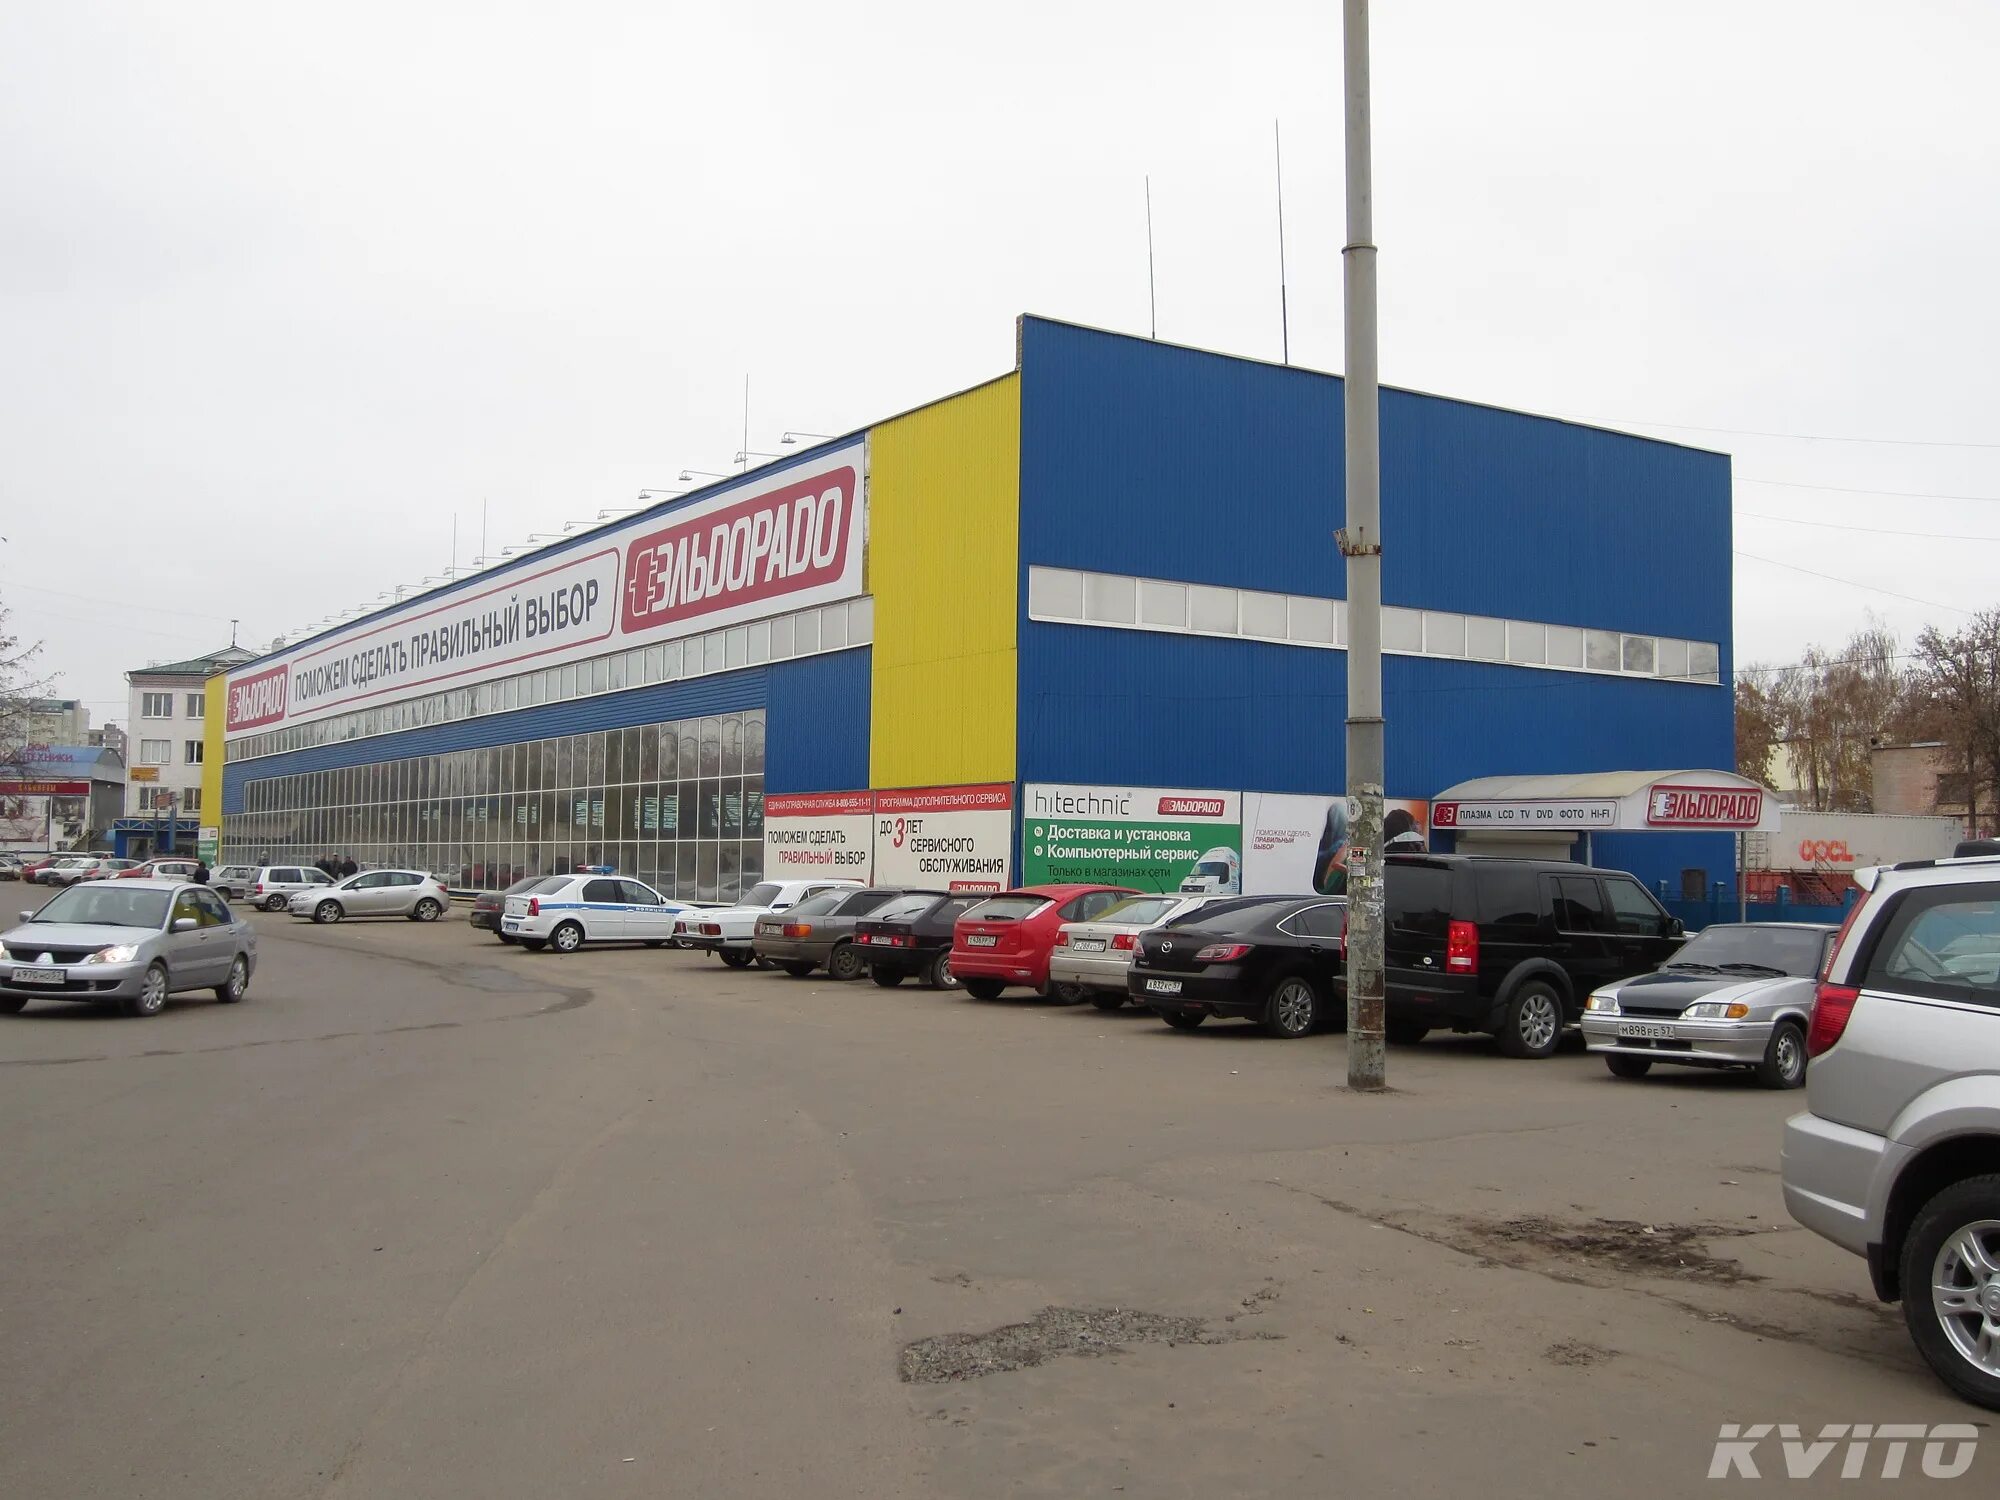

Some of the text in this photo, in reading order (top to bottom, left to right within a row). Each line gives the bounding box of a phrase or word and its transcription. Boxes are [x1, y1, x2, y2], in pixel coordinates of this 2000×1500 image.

[295, 578, 599, 702] ПОМОЖЕМ СДЕЛАТЬ ПРАВИЛЬНЫЙ ВЫБОР
[768, 797, 871, 810] ЕДИНАЯ СПРАВОЧНАЯ СЛУЖБА 8-800-555-11-11
[879, 792, 1006, 808] ПРОГРАММА ДОПОЛНИТЕЛЬНОГО СЕРВИСА
[1035, 790, 1130, 818] hitechnic
[1459, 807, 1610, 820] ПЛАЗМА LCD TV DVD ФОТО HI-FI
[768, 830, 846, 846] ПОМОЖЕМ СДЕЛАТЬ
[880, 817, 923, 848] ДО 3 ЛЕТ
[1047, 825, 1191, 845] Доставка и установка
[1255, 836, 1295, 844] ПРАВИЛЬНЫЙ
[1256, 829, 1312, 838] ПОМОЖЕМ СДЕЛАТЬ
[910, 838, 974, 853] СЕРВИСНОГО
[1799, 839, 1856, 862] OOCL
[779, 848, 866, 865] ПРАВИЛЬНЫЙ ВЫБОР
[1047, 845, 1199, 863] Компьютерный сервис
[919, 858, 1004, 873] ОБСЛУЖИВАНИЯ
[1047, 864, 1171, 878] Только в магазинах сети
[1621, 1025, 1659, 1037] М898РЕ
